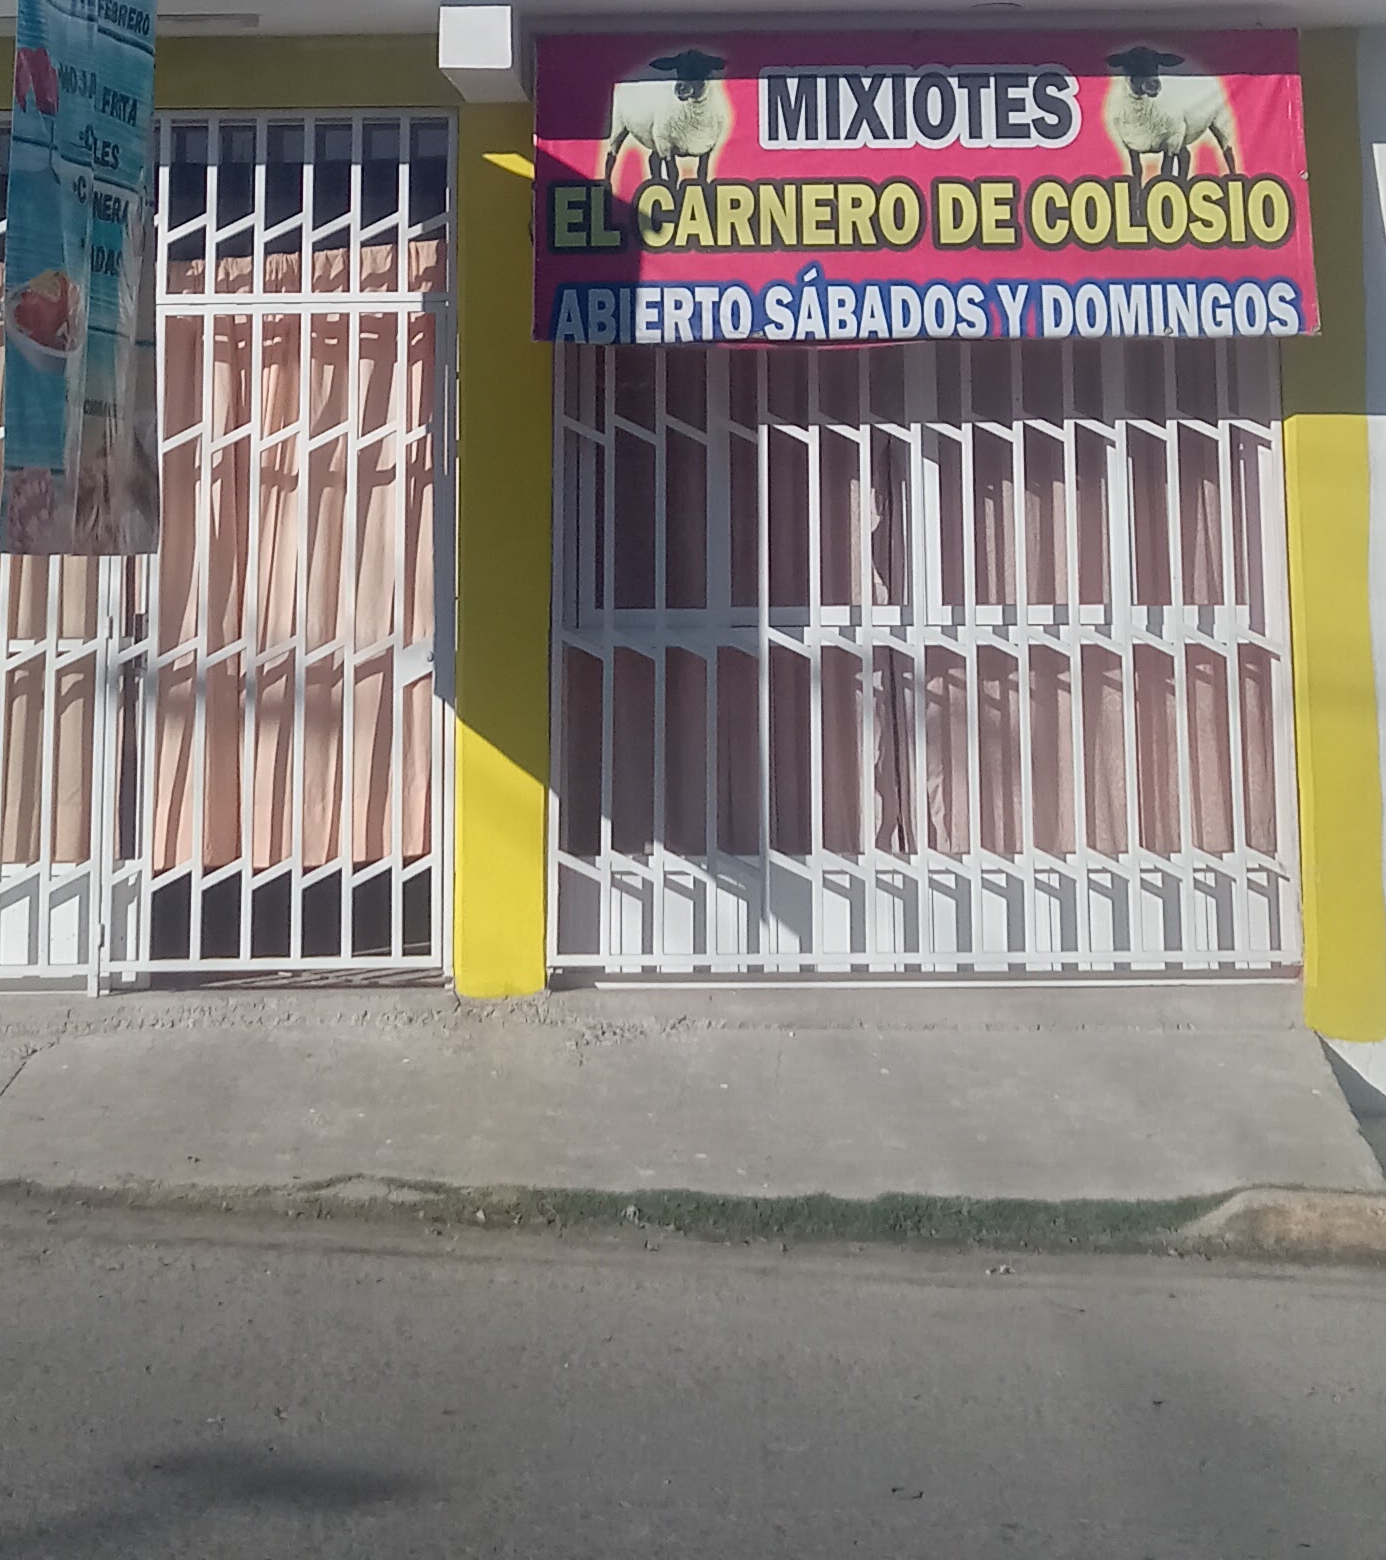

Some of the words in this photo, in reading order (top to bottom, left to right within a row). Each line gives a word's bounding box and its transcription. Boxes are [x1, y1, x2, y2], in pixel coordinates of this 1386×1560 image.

[765, 71, 1074, 142] MIXIOTES
[554, 182, 621, 248] EL
[637, 181, 921, 248] CARNERO
[937, 181, 1017, 245] DE
[1031, 179, 1292, 245] COLOSIO
[555, 285, 753, 344] ABIERTO
[763, 266, 988, 341] SÁBADOS
[1000, 283, 1030, 339] Y
[1041, 281, 1301, 339] DOMINGOS
